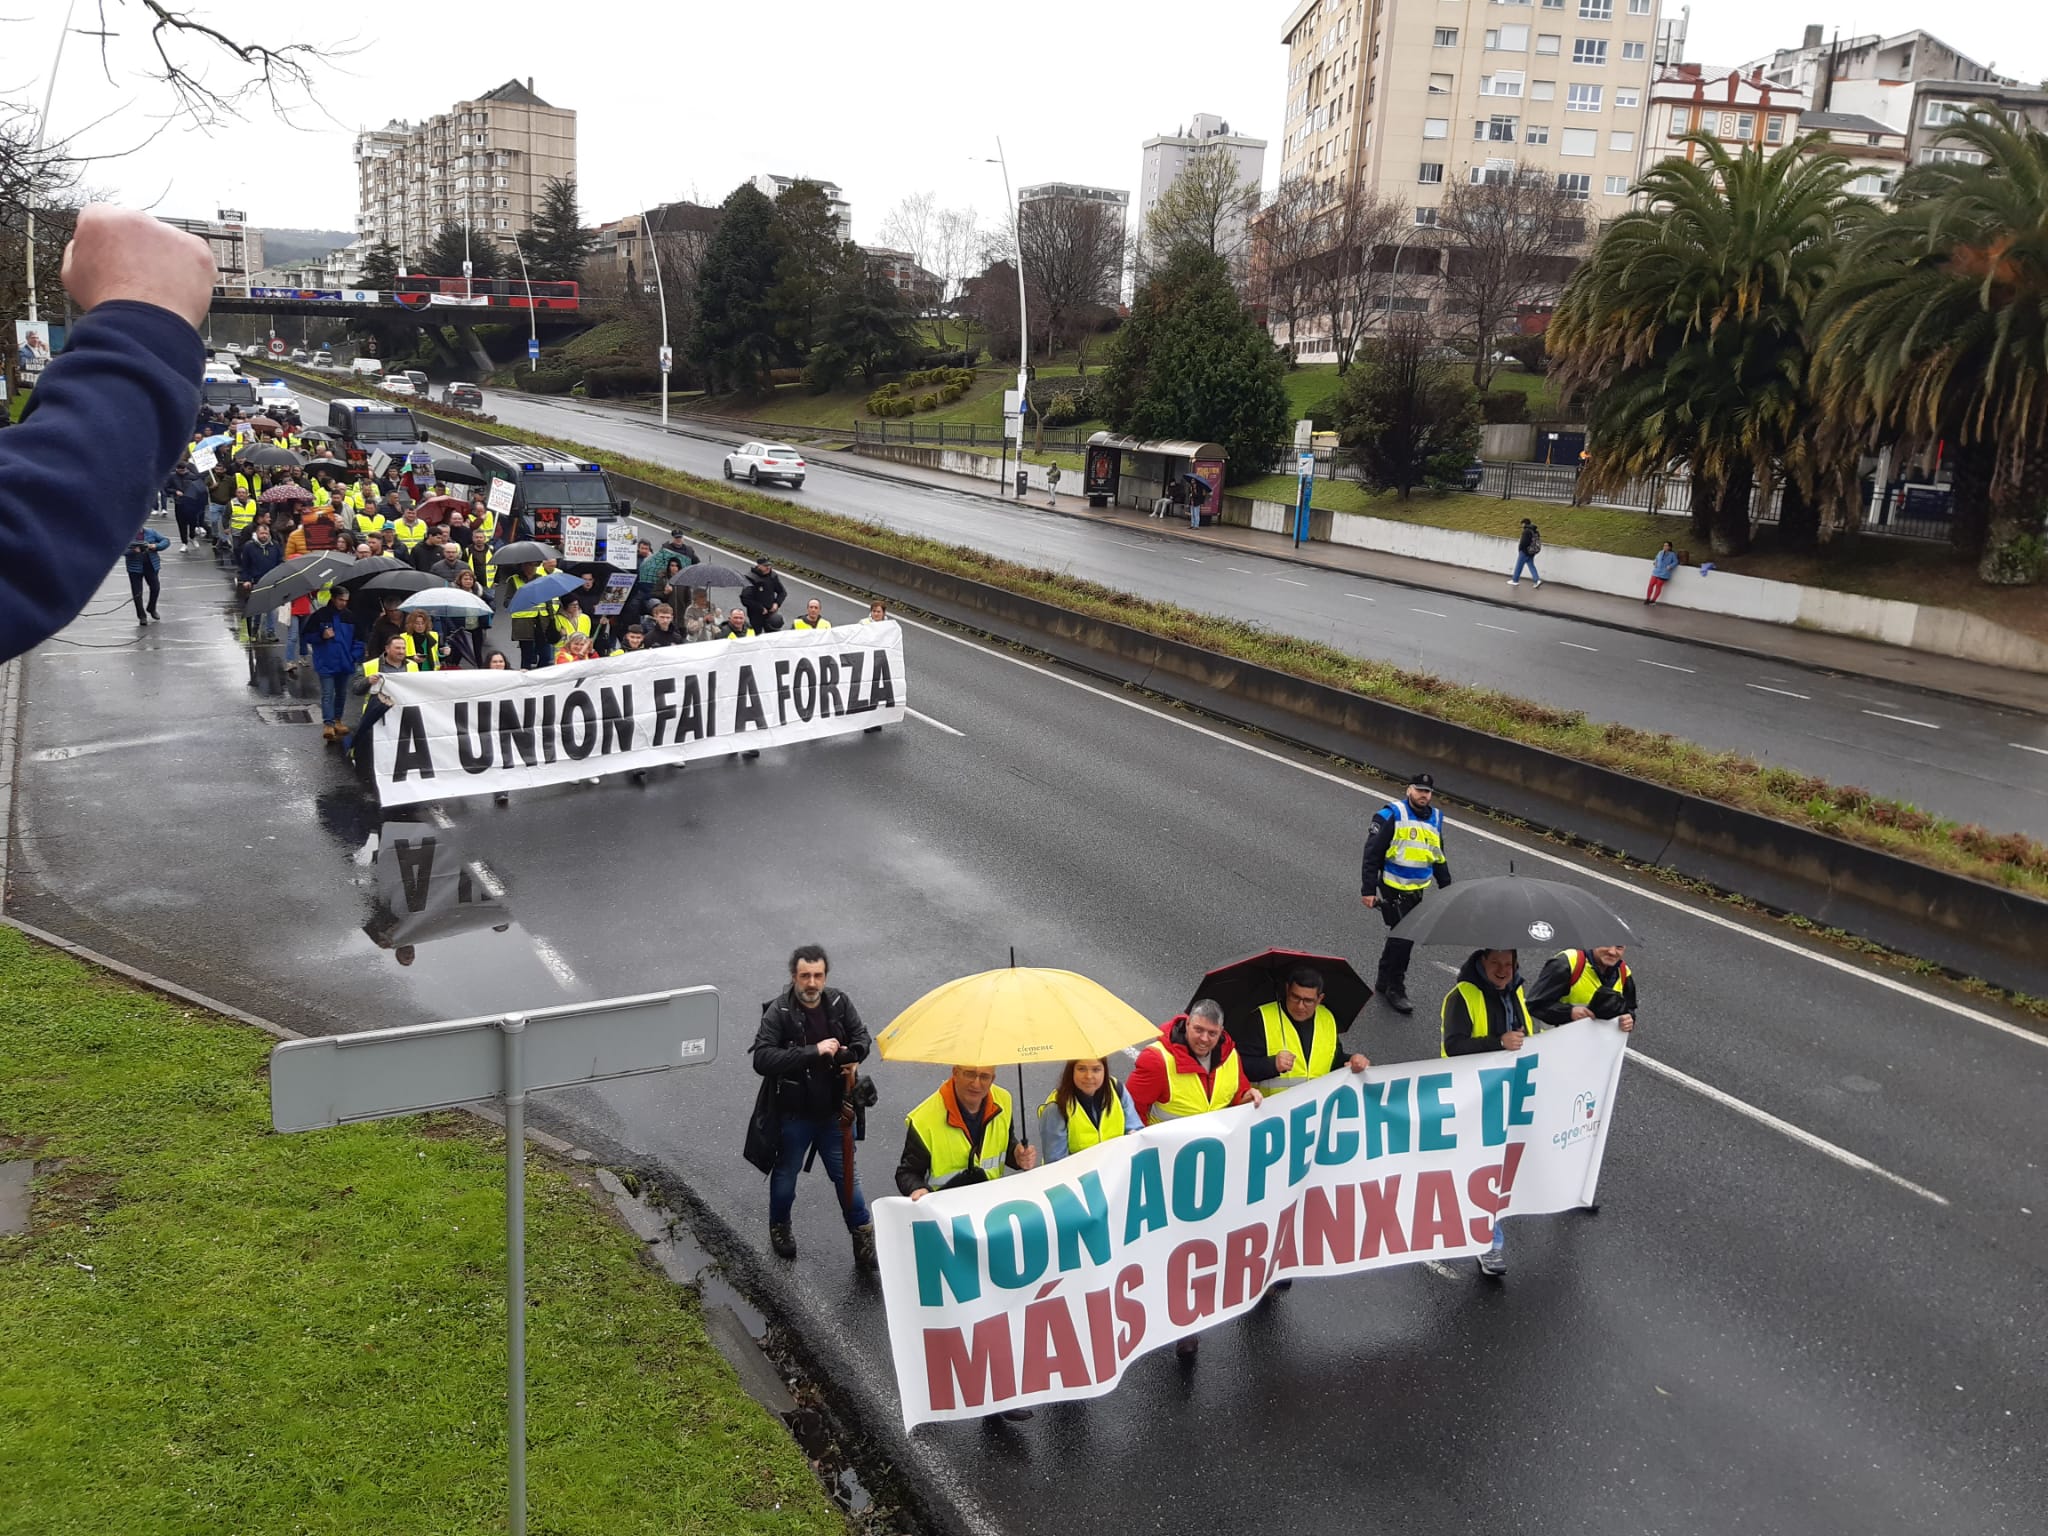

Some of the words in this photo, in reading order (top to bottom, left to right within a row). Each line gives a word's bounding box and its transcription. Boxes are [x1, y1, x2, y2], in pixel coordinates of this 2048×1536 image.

[392, 705, 436, 783] A
[453, 676, 635, 775] UNIÓN
[653, 670, 718, 747] FAI
[734, 664, 768, 734] A
[775, 649, 896, 726] FORZA
[912, 1170, 1112, 1307] NON
[1123, 1136, 1226, 1246] AO
[1247, 1072, 1458, 1206] PECHE
[1479, 1053, 1539, 1148] DE
[923, 1263, 1147, 1412] MÁIS
[1166, 1142, 1525, 1327] GRANXAS!
